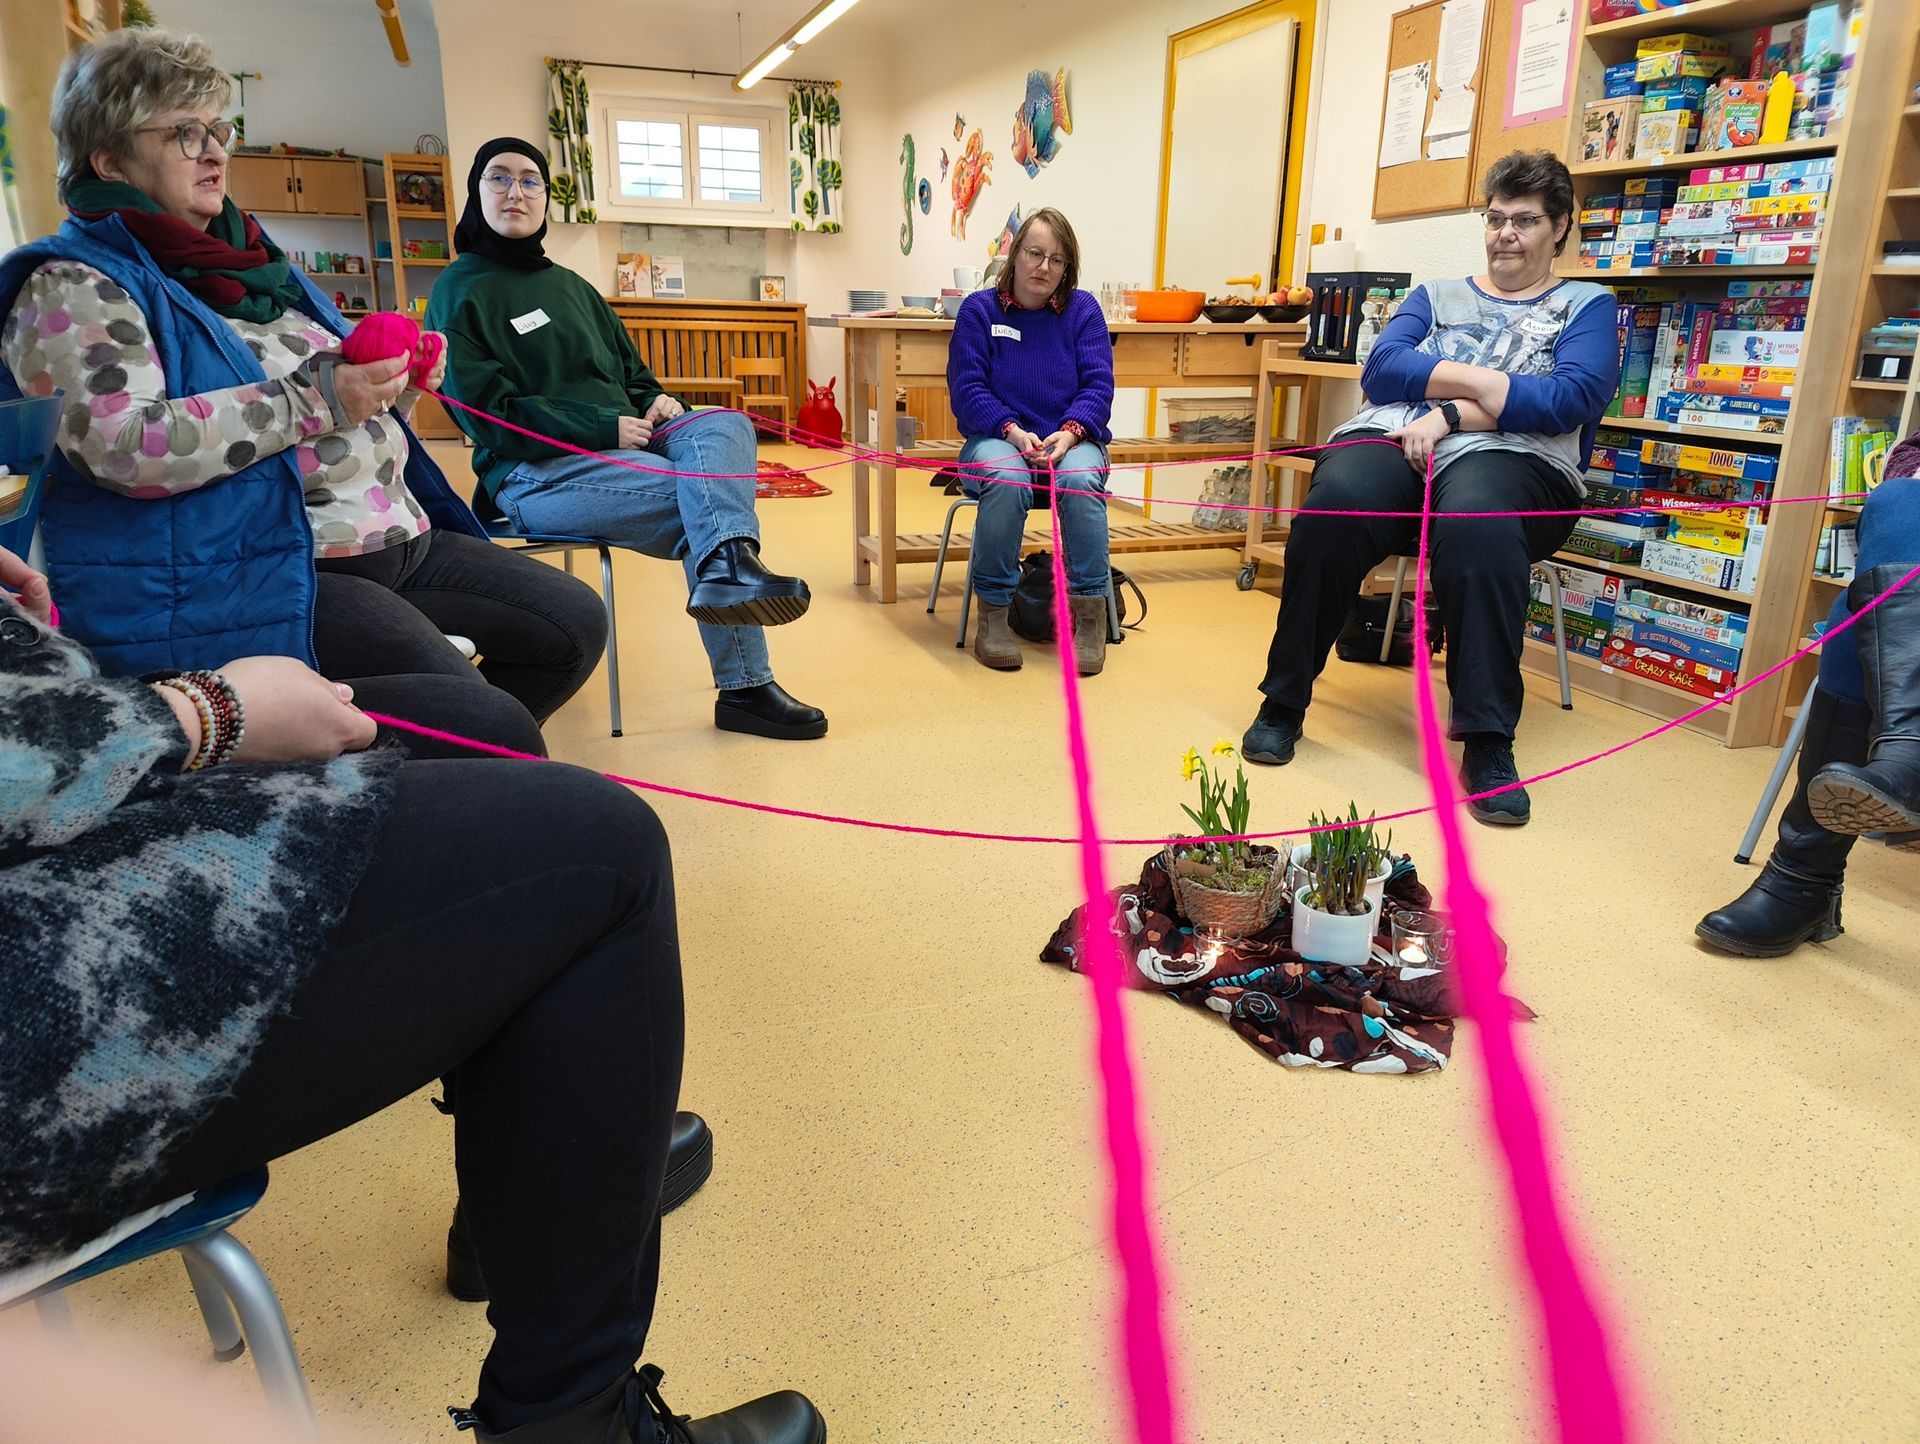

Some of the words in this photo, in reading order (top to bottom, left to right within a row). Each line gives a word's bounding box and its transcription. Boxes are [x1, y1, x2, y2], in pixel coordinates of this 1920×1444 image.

[1675, 207, 1687, 215] 200
[1692, 333, 1702, 360] MEMO
[1691, 380, 1706, 389] 100
[1708, 451, 1734, 468] 1000
[1727, 509, 1732, 518] 3
[1739, 511, 1746, 520] 5
[1724, 529, 1741, 540] HABA
[1721, 560, 1732, 588] KOSMOS
[1565, 591, 1585, 607] 1000
[1634, 658, 1667, 678] CRAZY
[1668, 670, 1695, 688] RACE
